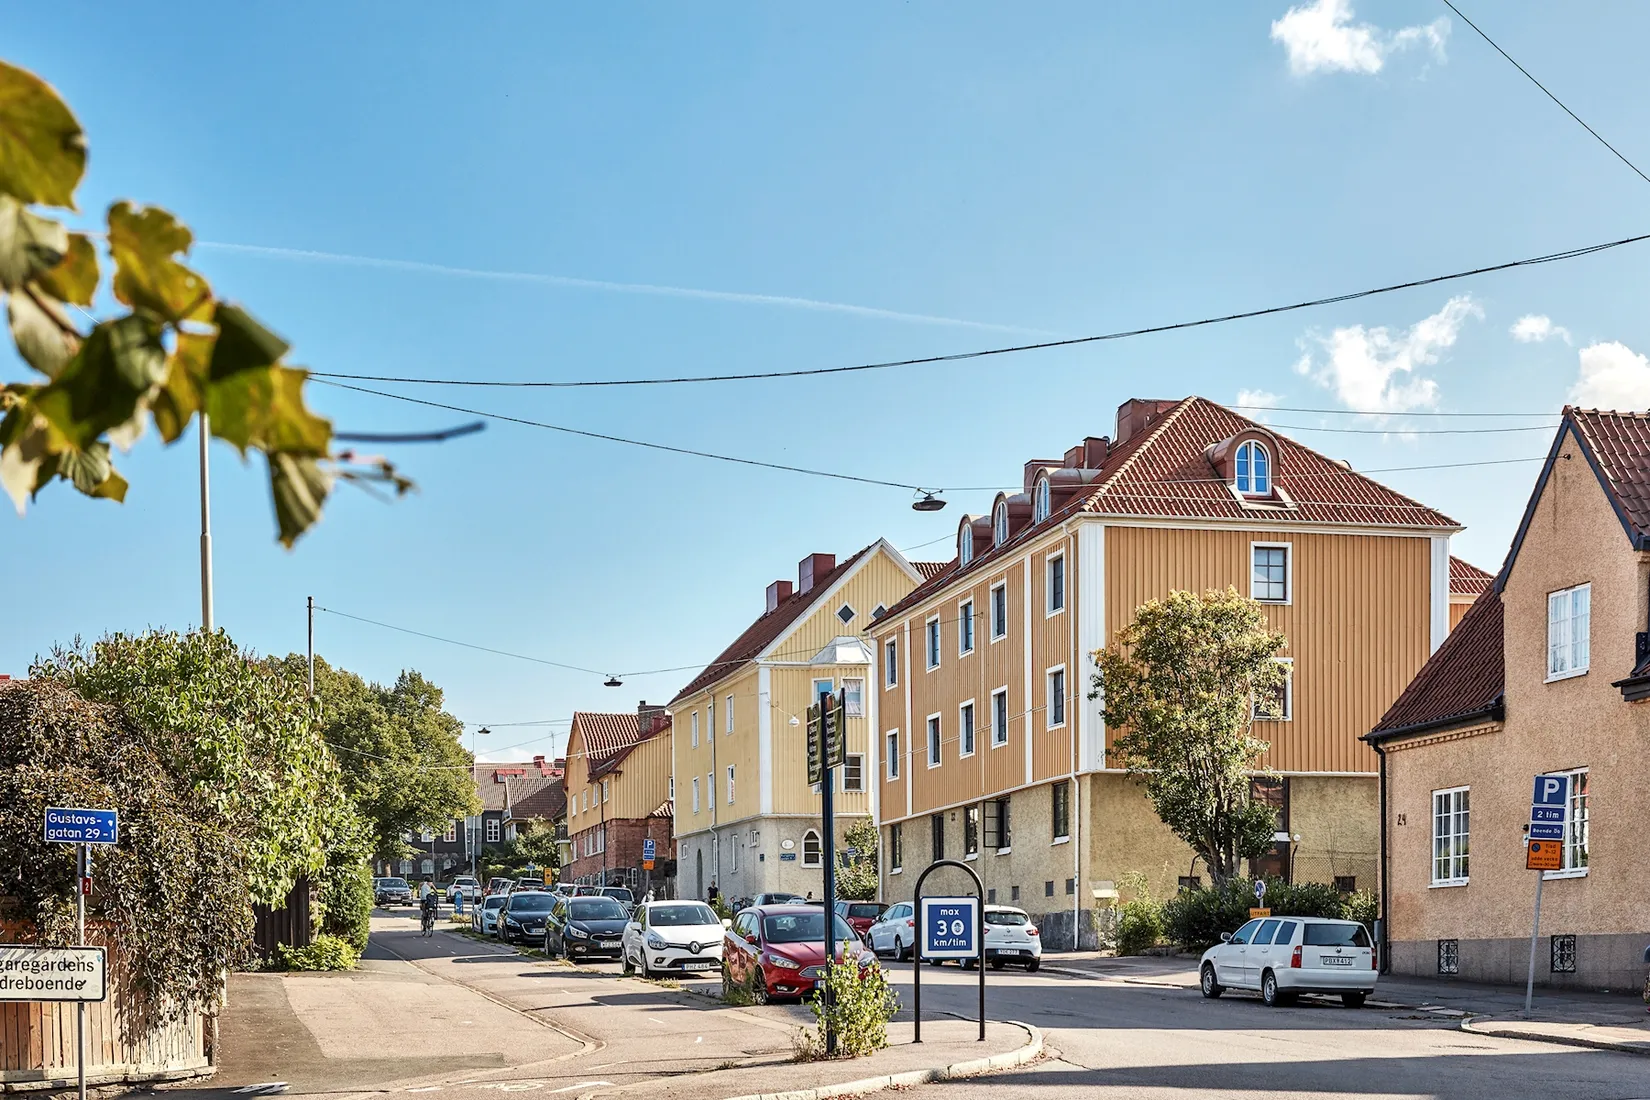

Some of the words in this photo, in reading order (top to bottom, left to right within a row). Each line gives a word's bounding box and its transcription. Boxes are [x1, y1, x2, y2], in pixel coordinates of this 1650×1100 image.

[1543, 779, 1560, 802] P
[48, 813, 102, 824] Gustavs-
[48, 828, 82, 839] gatan
[85, 882, 90, 891] 2
[936, 920, 964, 936] 30
[934, 938, 966, 946] km/tim
[0, 976, 84, 990] dreboende
